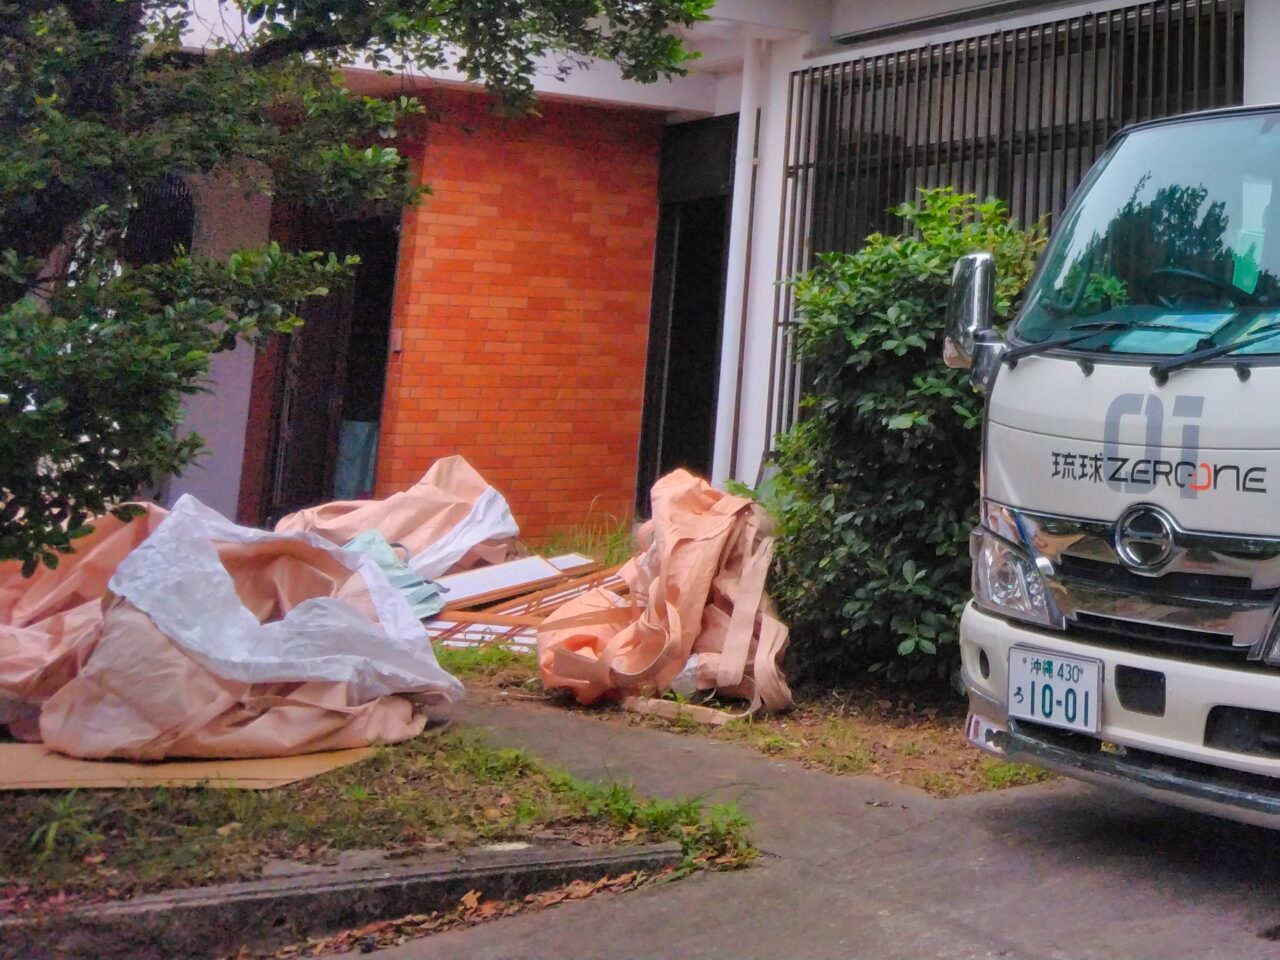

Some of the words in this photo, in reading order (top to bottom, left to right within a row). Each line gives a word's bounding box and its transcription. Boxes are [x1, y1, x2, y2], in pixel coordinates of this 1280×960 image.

[1030, 657, 1054, 679] 沖縄
[1057, 662, 1080, 683] 430
[1013, 686, 1025, 704] ろ
[1030, 680, 1089, 727] 10-01
